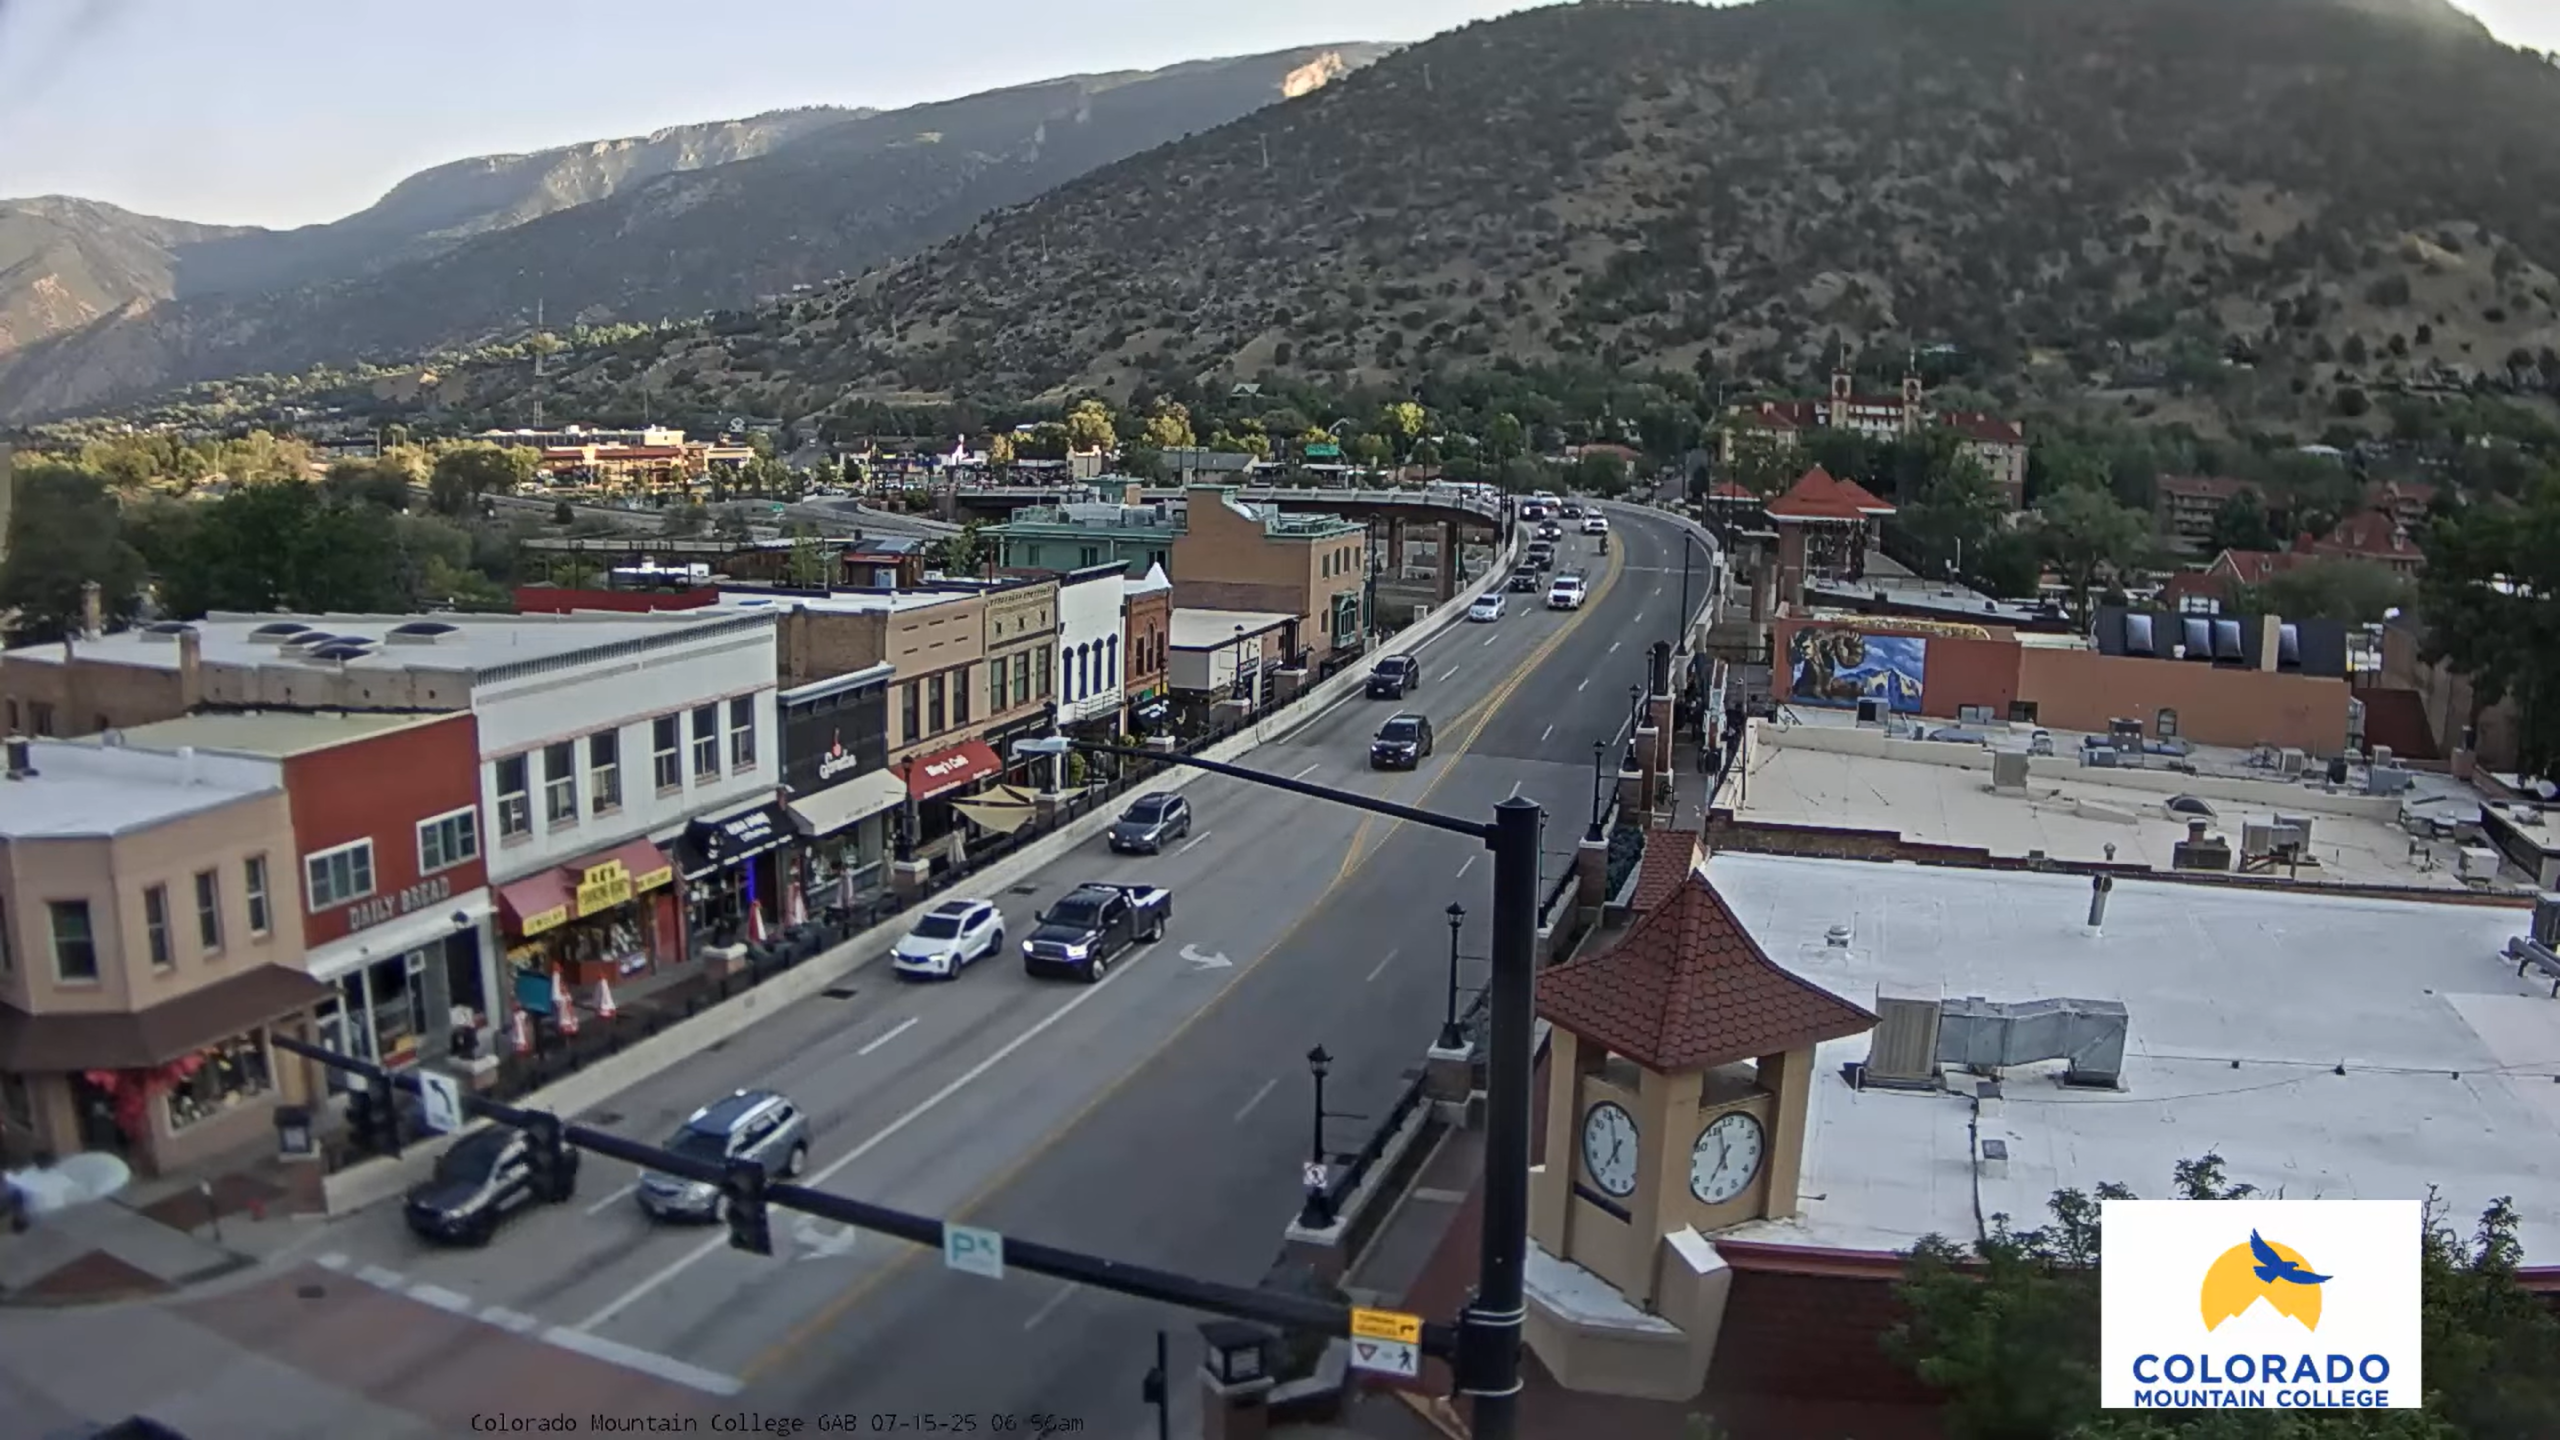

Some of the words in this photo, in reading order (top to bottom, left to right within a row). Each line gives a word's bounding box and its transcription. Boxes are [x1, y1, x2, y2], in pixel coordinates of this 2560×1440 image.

[348, 894, 396, 931] DAILY
[400, 875, 451, 913] BREAD
[1722, 1117, 1734, 1128] 12
[951, 1231, 975, 1262] P
